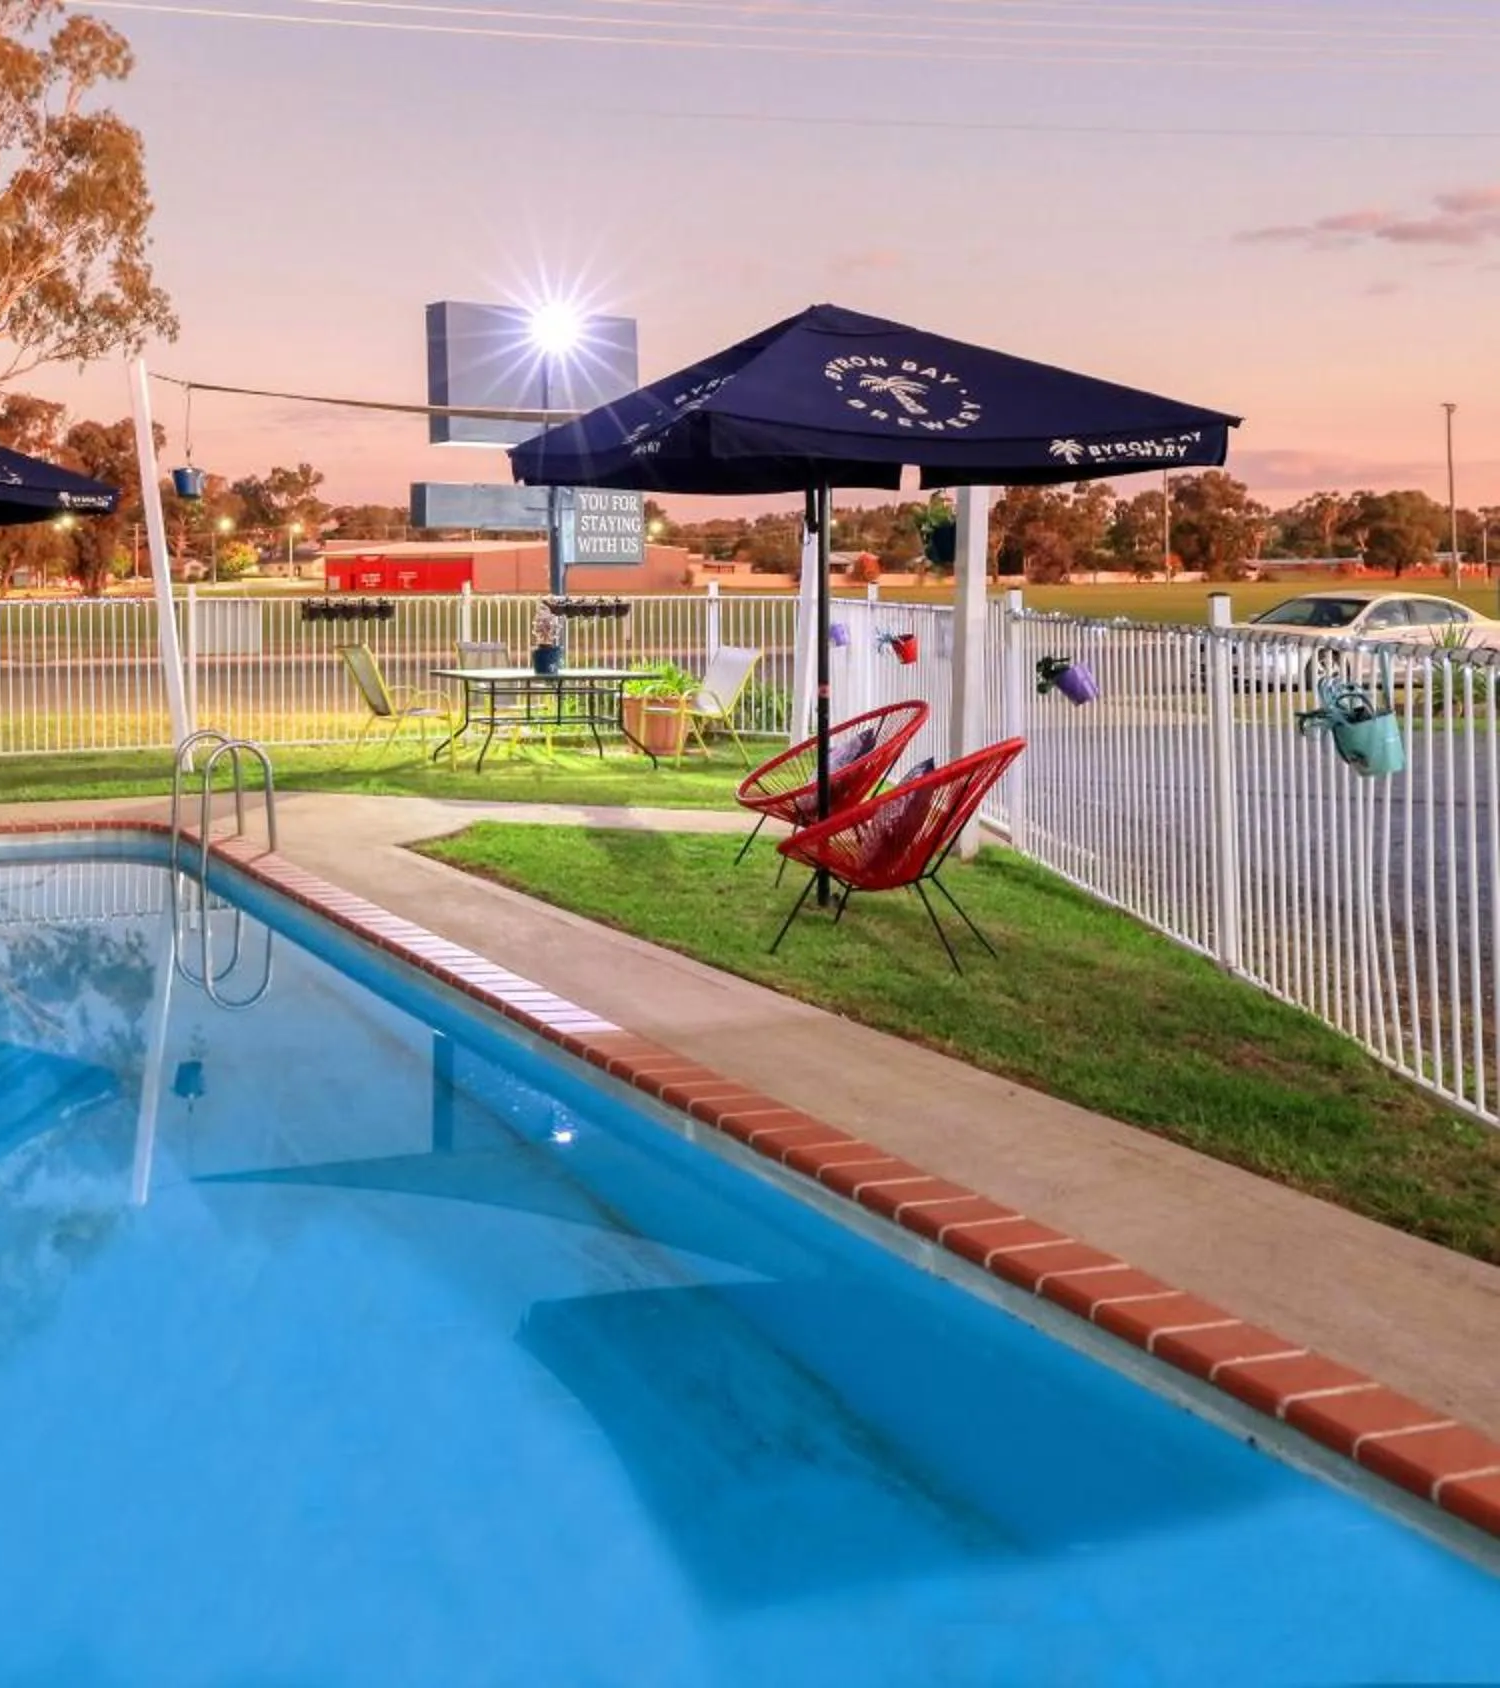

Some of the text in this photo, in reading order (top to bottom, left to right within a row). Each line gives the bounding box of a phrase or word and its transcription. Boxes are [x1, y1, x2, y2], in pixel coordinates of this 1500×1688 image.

[825, 355, 959, 384] BYRON BAY
[578, 493, 638, 512] YOU FOR
[581, 515, 641, 533] STAYING
[577, 536, 639, 553] WITH US
